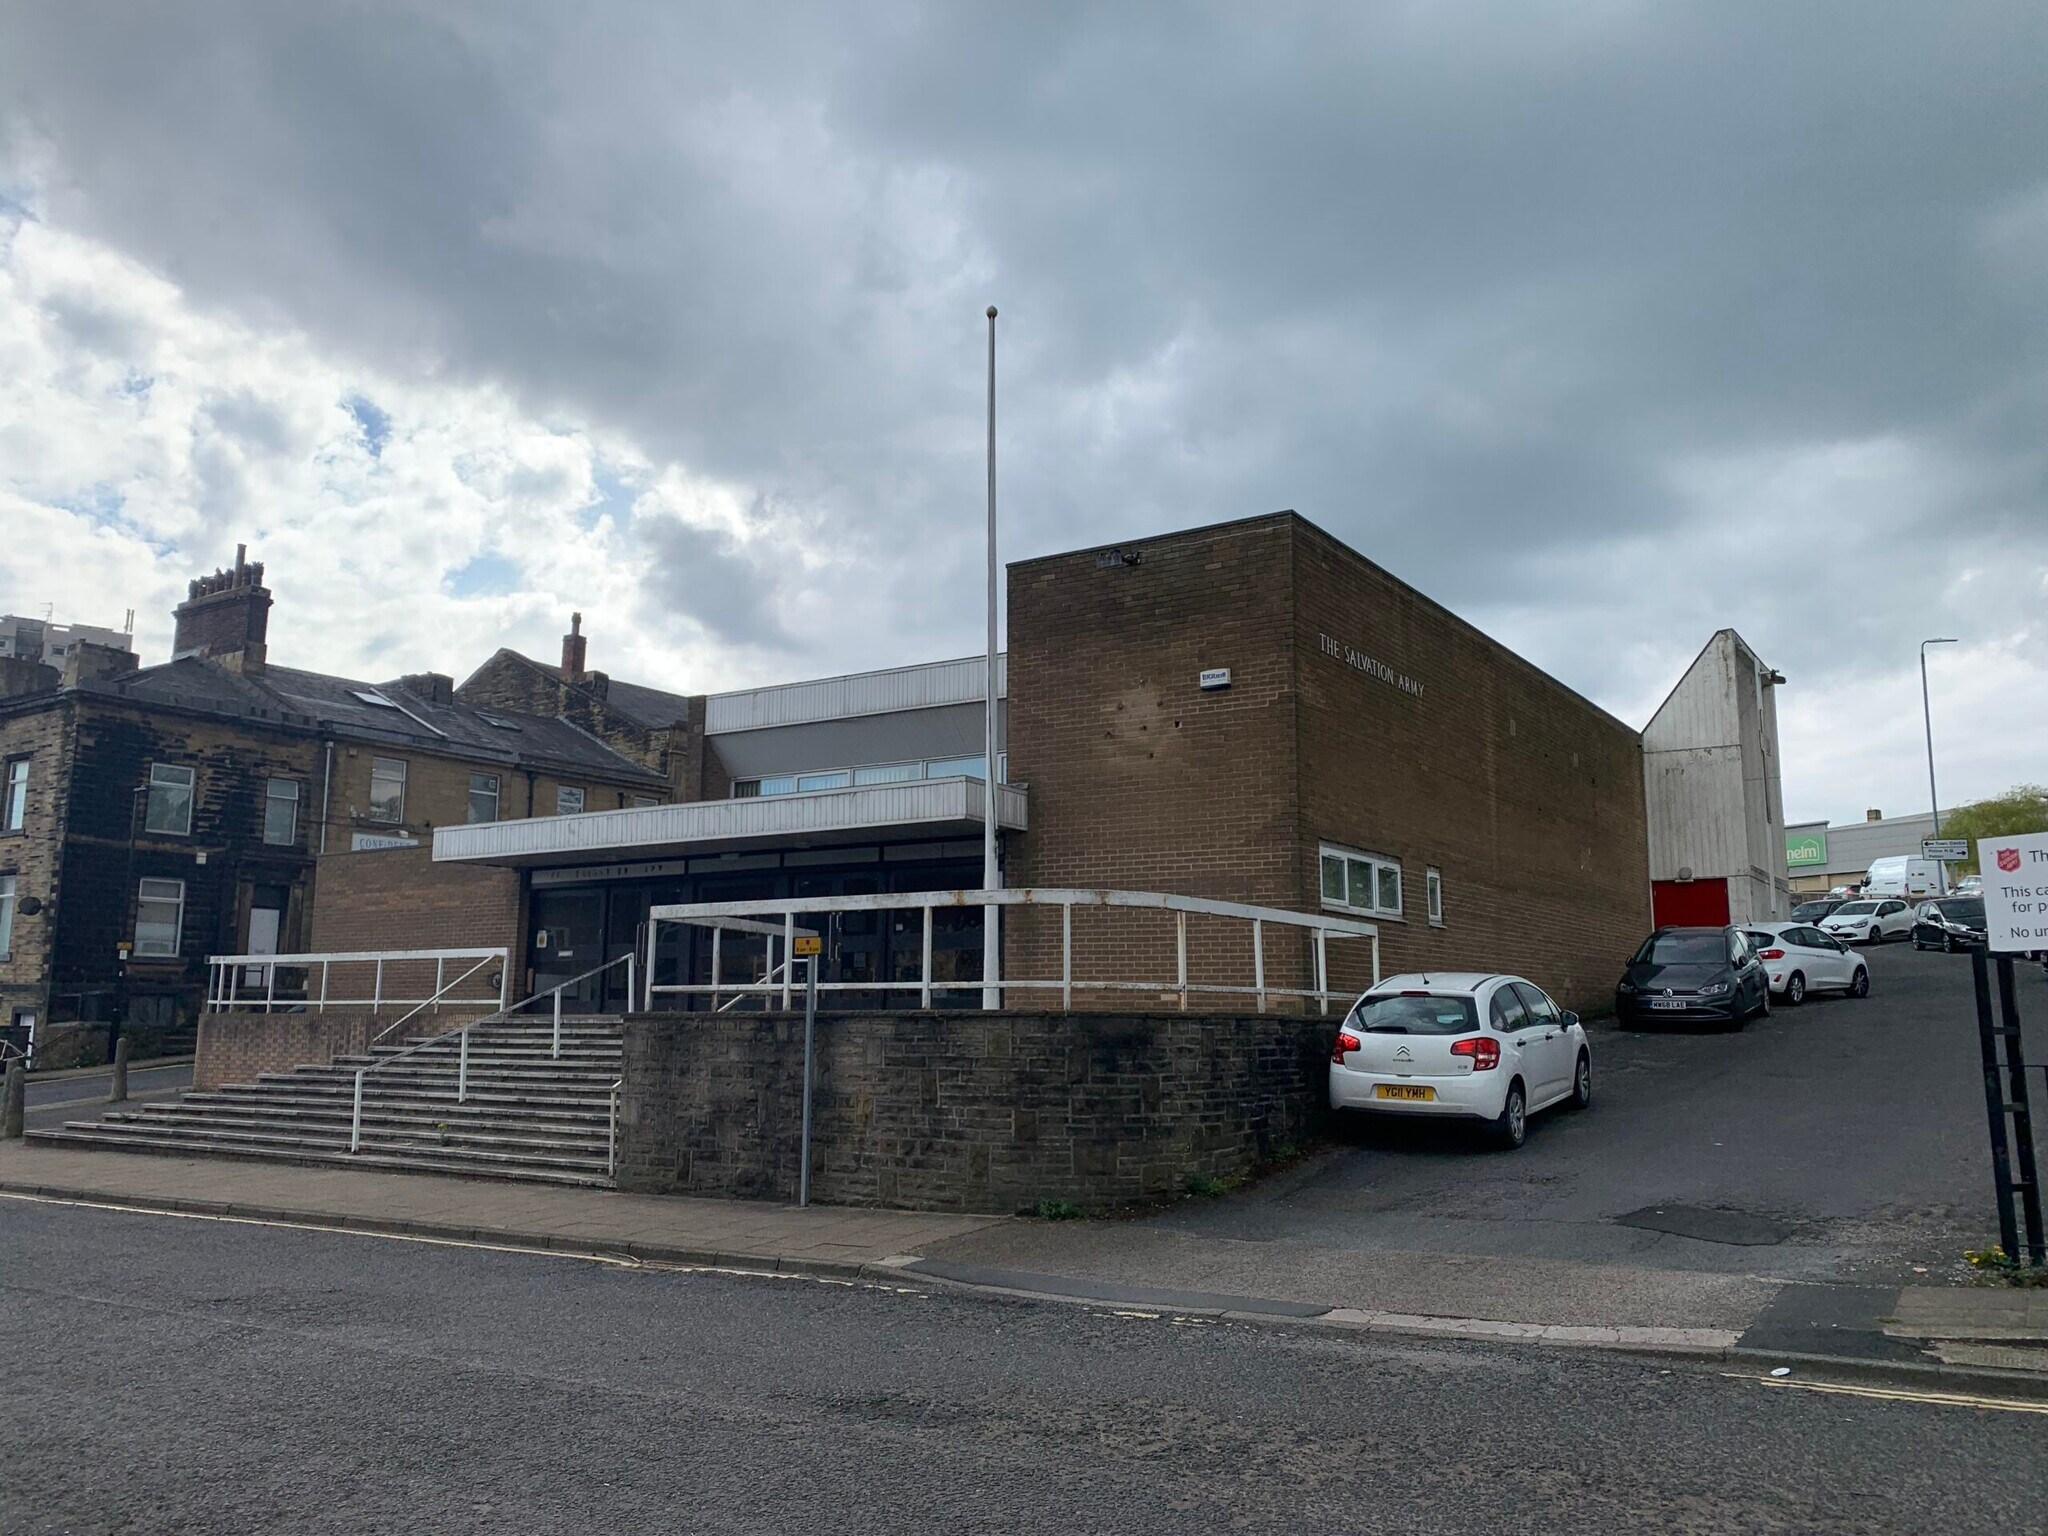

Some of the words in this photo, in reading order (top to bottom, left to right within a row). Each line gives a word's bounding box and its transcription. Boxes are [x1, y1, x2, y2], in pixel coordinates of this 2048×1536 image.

[1319, 632, 1340, 659] THE
[1344, 645, 1394, 685] SALVATION
[1398, 674, 1425, 698] ARMY
[2000, 885, 2031, 898] This
[2012, 901, 2033, 913] for
[2010, 926, 2030, 939] No
[1384, 1086, 1403, 1098] YG11
[1405, 1087, 1426, 1099] YMH
